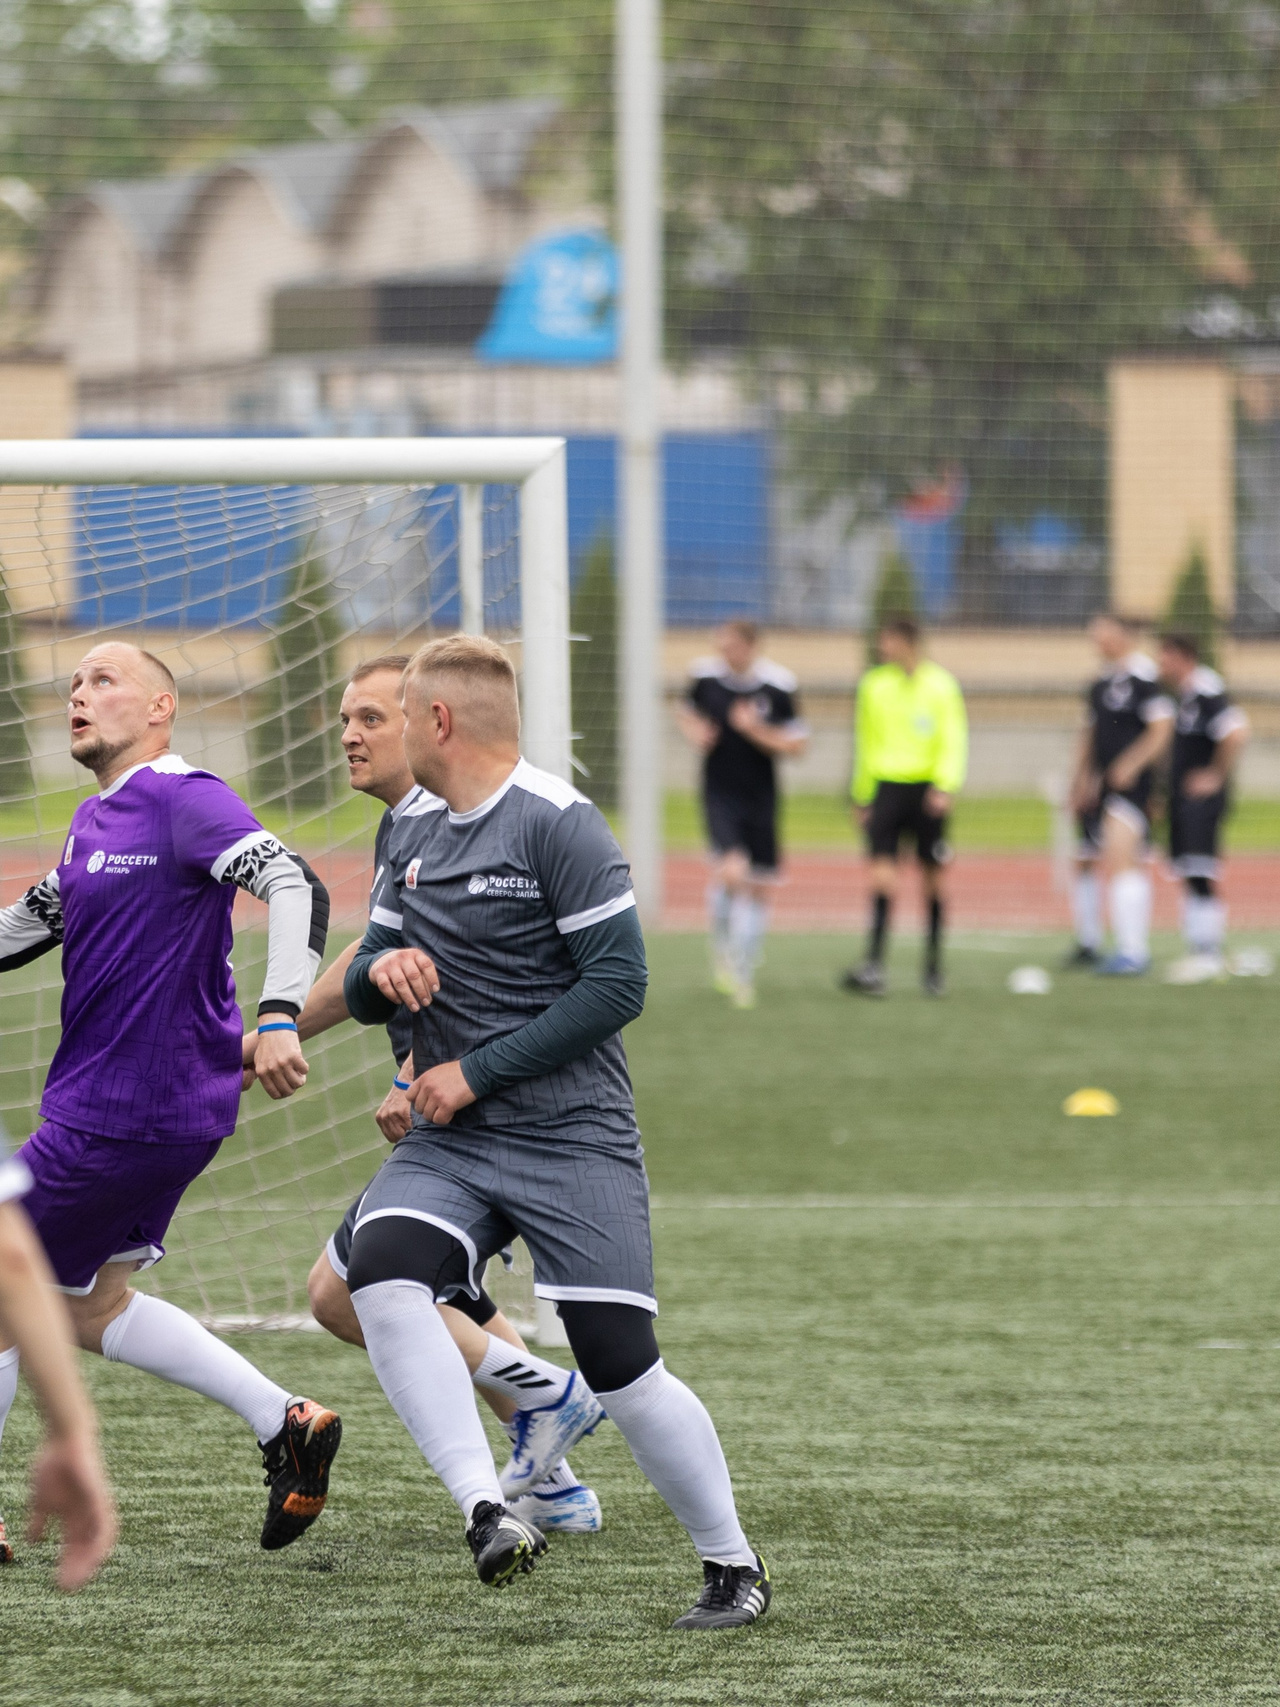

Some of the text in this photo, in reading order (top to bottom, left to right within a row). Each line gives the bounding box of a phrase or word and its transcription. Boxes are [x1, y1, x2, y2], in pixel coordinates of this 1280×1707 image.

[106, 854, 158, 866] РОССЕТИ
[104, 866, 131, 875] ЯНТАРЬ
[489, 875, 538, 889] РОССЕТИ
[486, 889, 540, 899] СЕВЕРО-ЗАПАД
